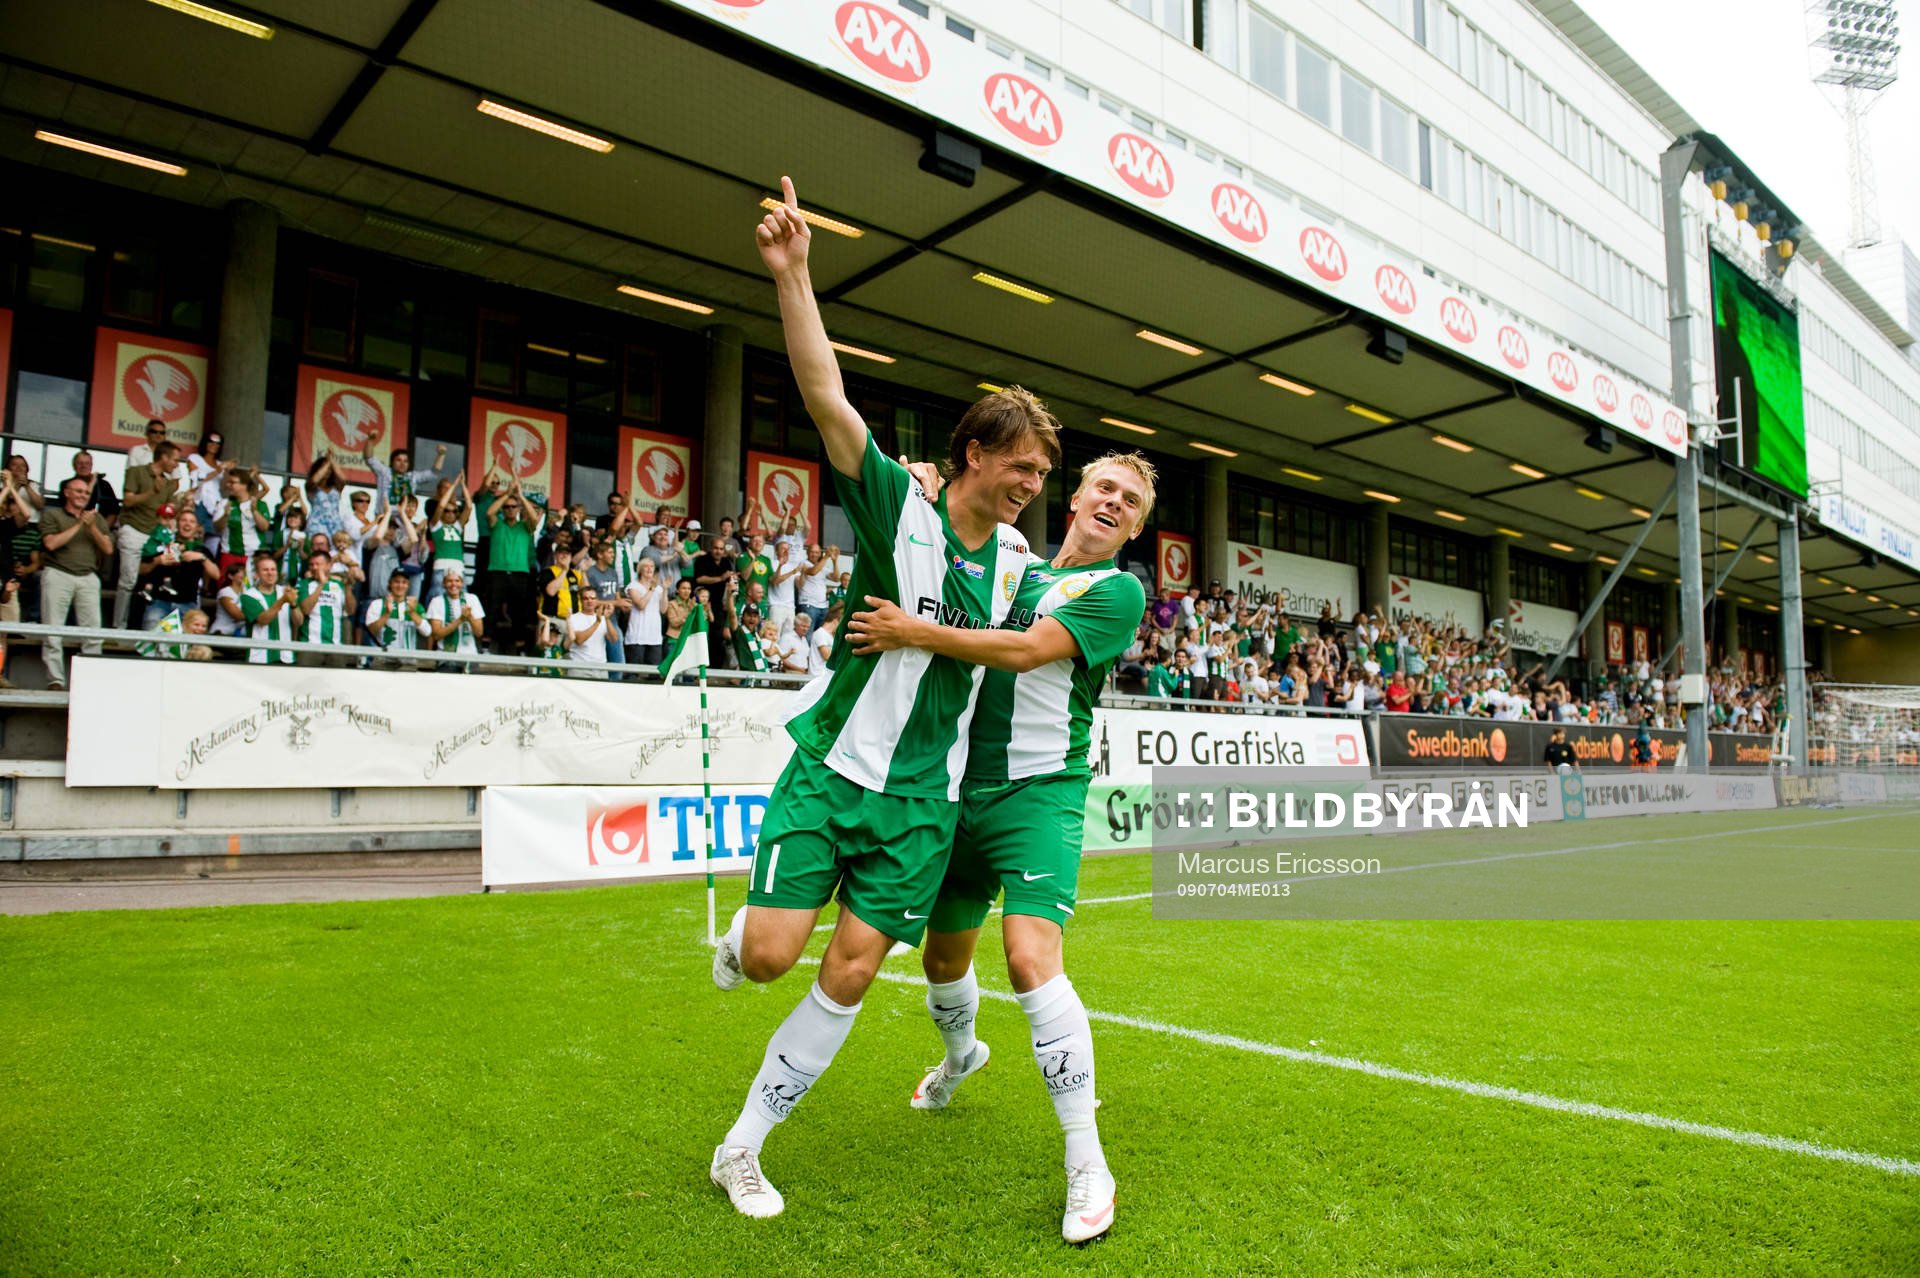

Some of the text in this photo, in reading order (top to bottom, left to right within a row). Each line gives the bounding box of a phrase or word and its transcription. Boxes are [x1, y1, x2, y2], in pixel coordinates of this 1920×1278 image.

[843, 6, 923, 77] AXA
[990, 78, 1056, 141] AXA
[1113, 137, 1170, 193] AXA
[1216, 188, 1265, 239] AXA
[1303, 231, 1345, 275] AXA
[1378, 268, 1415, 311] AXA
[1442, 300, 1476, 341] AXA
[1500, 328, 1528, 363] AXA
[1549, 354, 1577, 387] AXA
[117, 419, 197, 442] Kunrnen
[635, 498, 686, 513] Kungnen
[917, 597, 999, 630] FINL
[1239, 580, 1326, 616] MekoPartne
[686, 710, 736, 731] Aktbolaget
[1137, 730, 1305, 765] EO Grafiska
[1407, 729, 1490, 758] Swedbank
[1554, 735, 1610, 760] edbank
[1585, 784, 1684, 806] IKEFOOTBALL.COM
[1107, 789, 1216, 842] Gröna
[936, 1016, 973, 1032] LCON
[1046, 1069, 1090, 1090] ALCON
[762, 1083, 794, 1114] FALC
